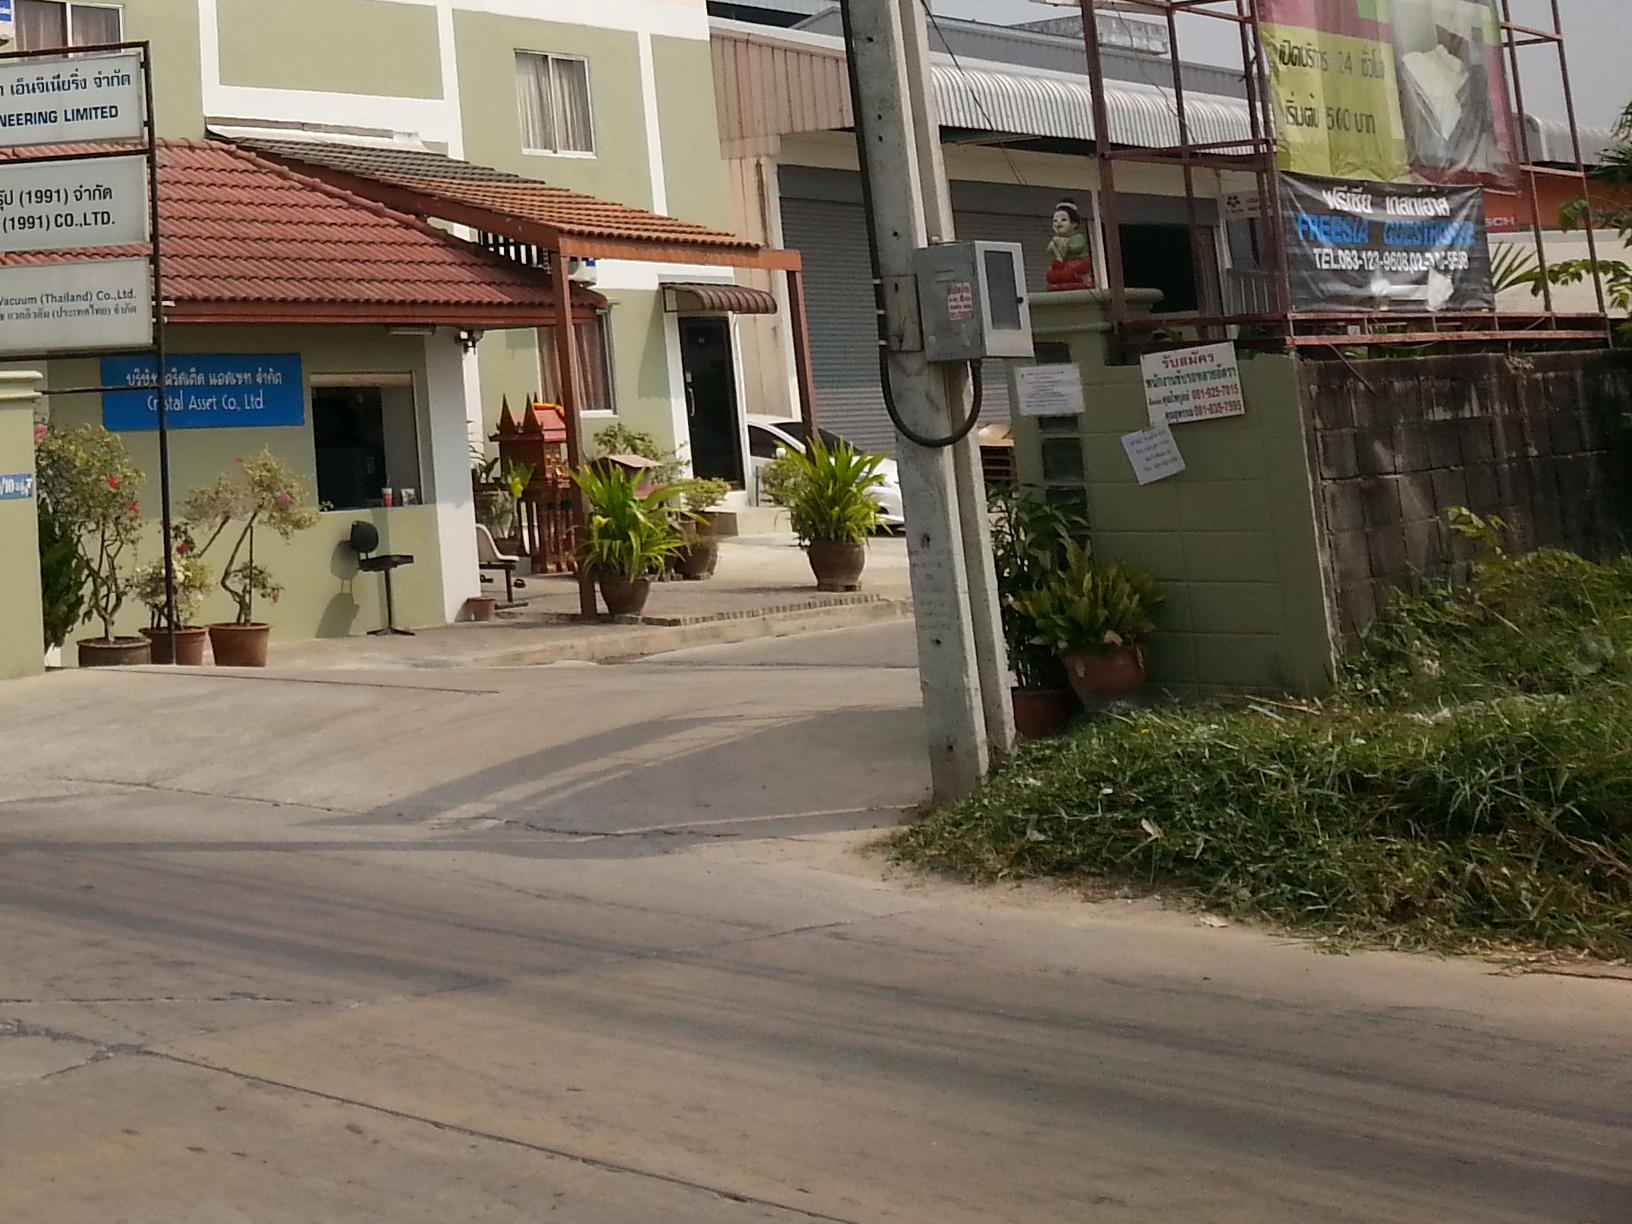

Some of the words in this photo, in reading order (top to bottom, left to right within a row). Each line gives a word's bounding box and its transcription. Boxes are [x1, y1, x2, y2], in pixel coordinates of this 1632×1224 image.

[94, 69, 131, 91] จำกัด
[64, 105, 119, 122] LIMITED
[1355, 111, 1377, 135] บาท
[19, 188, 69, 208] (1991)
[74, 184, 113, 203] จำกัด
[3, 214, 51, 233] (1991)
[54, 211, 116, 229] CO.,LTD.
[40, 290, 93, 306] (Thailand)
[96, 288, 137, 302] Co.,Ltd.
[148, 389, 183, 412] Crstal
[188, 395, 217, 411] Asset
[244, 389, 264, 410] Ltd
